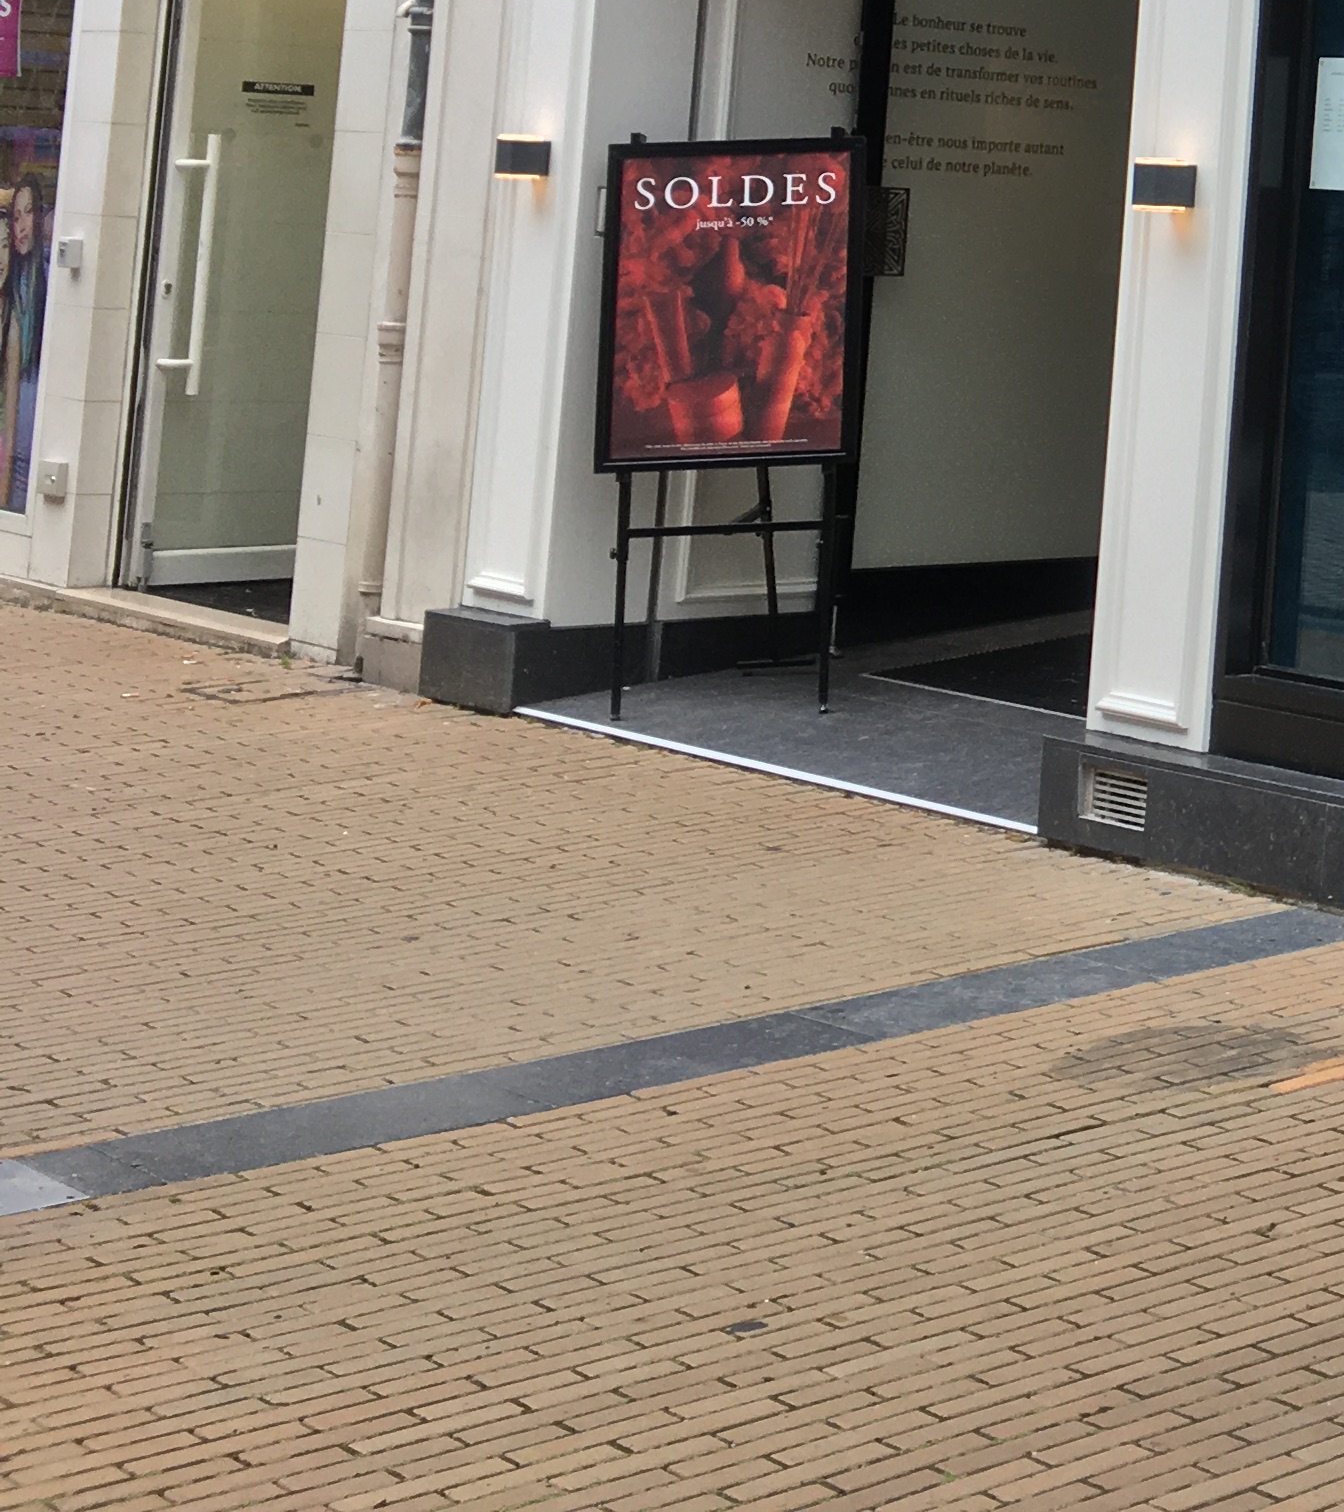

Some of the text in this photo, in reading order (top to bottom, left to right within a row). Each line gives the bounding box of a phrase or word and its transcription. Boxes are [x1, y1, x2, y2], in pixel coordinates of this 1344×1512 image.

[892, 12, 1027, 38] Le bonheur se trouve
[891, 37, 1059, 63] es petites choses de la vie.
[806, 53, 845, 70] Notre
[903, 62, 922, 76] est
[925, 62, 942, 77] de
[945, 64, 1020, 85] transformer
[1023, 73, 1044, 86] vos
[1047, 74, 1098, 90] routines
[253, 83, 302, 92] ATTENTION
[920, 88, 937, 101] en
[939, 88, 981, 104] rituels
[984, 90, 1023, 107] riches
[1025, 93, 1041, 109] de
[1043, 97, 1074, 111] sens.
[937, 136, 968, 150] nous
[971, 138, 1022, 155] importe
[1024, 142, 1065, 156] autant
[891, 156, 924, 171] celui
[926, 158, 942, 172] de
[945, 161, 980, 175] notre
[983, 161, 1034, 178] planète.
[634, 172, 838, 210] SOLDES
[695, 216, 734, 231] jusqu'à
[735, 217, 755, 227] -50
